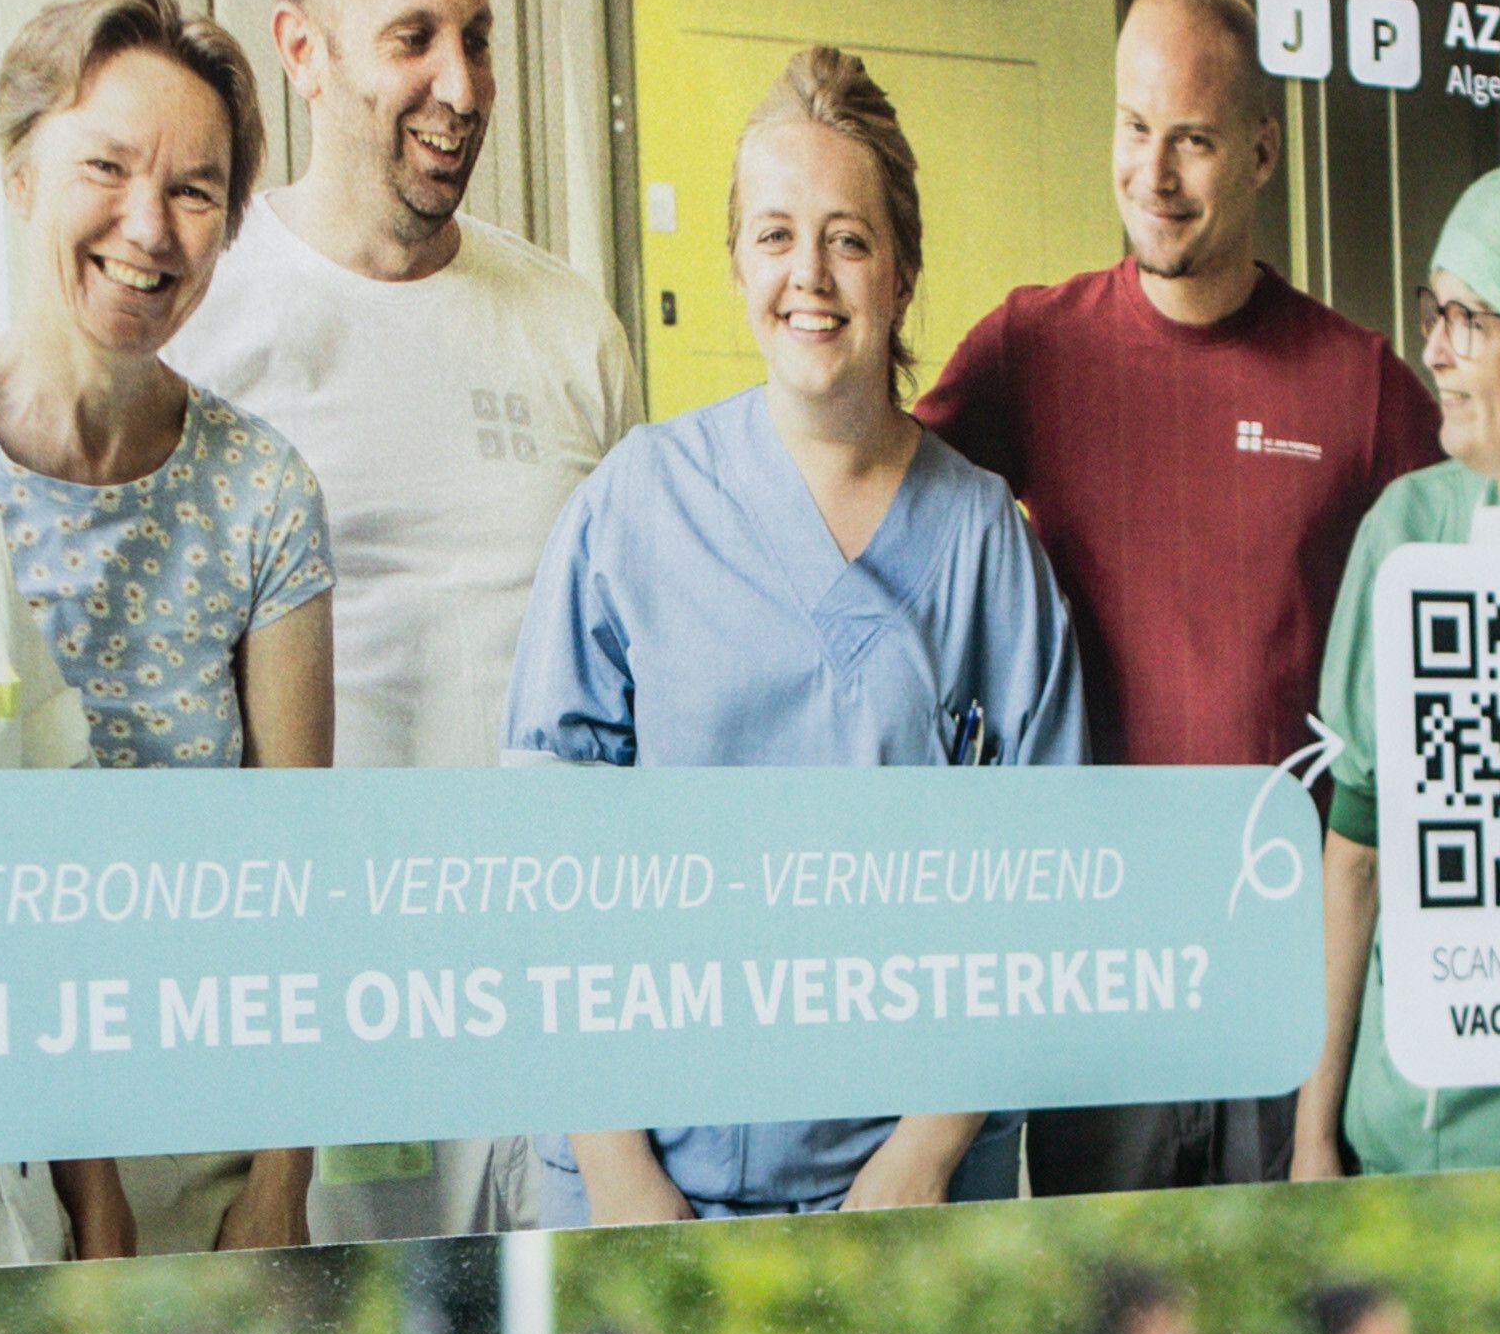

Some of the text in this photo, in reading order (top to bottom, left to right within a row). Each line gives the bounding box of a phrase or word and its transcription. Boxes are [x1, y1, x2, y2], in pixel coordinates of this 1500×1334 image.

[1281, 8, 1398, 61] J P
[365, 851, 715, 917] VERTROUWD
[760, 847, 1124, 907] VERNIEUWEND
[35, 978, 133, 1056] JE
[158, 972, 322, 1049] MEE
[344, 968, 507, 1042] ONS
[526, 960, 723, 1034] TEAM
[741, 944, 1211, 1026] VERSTERKEN?
